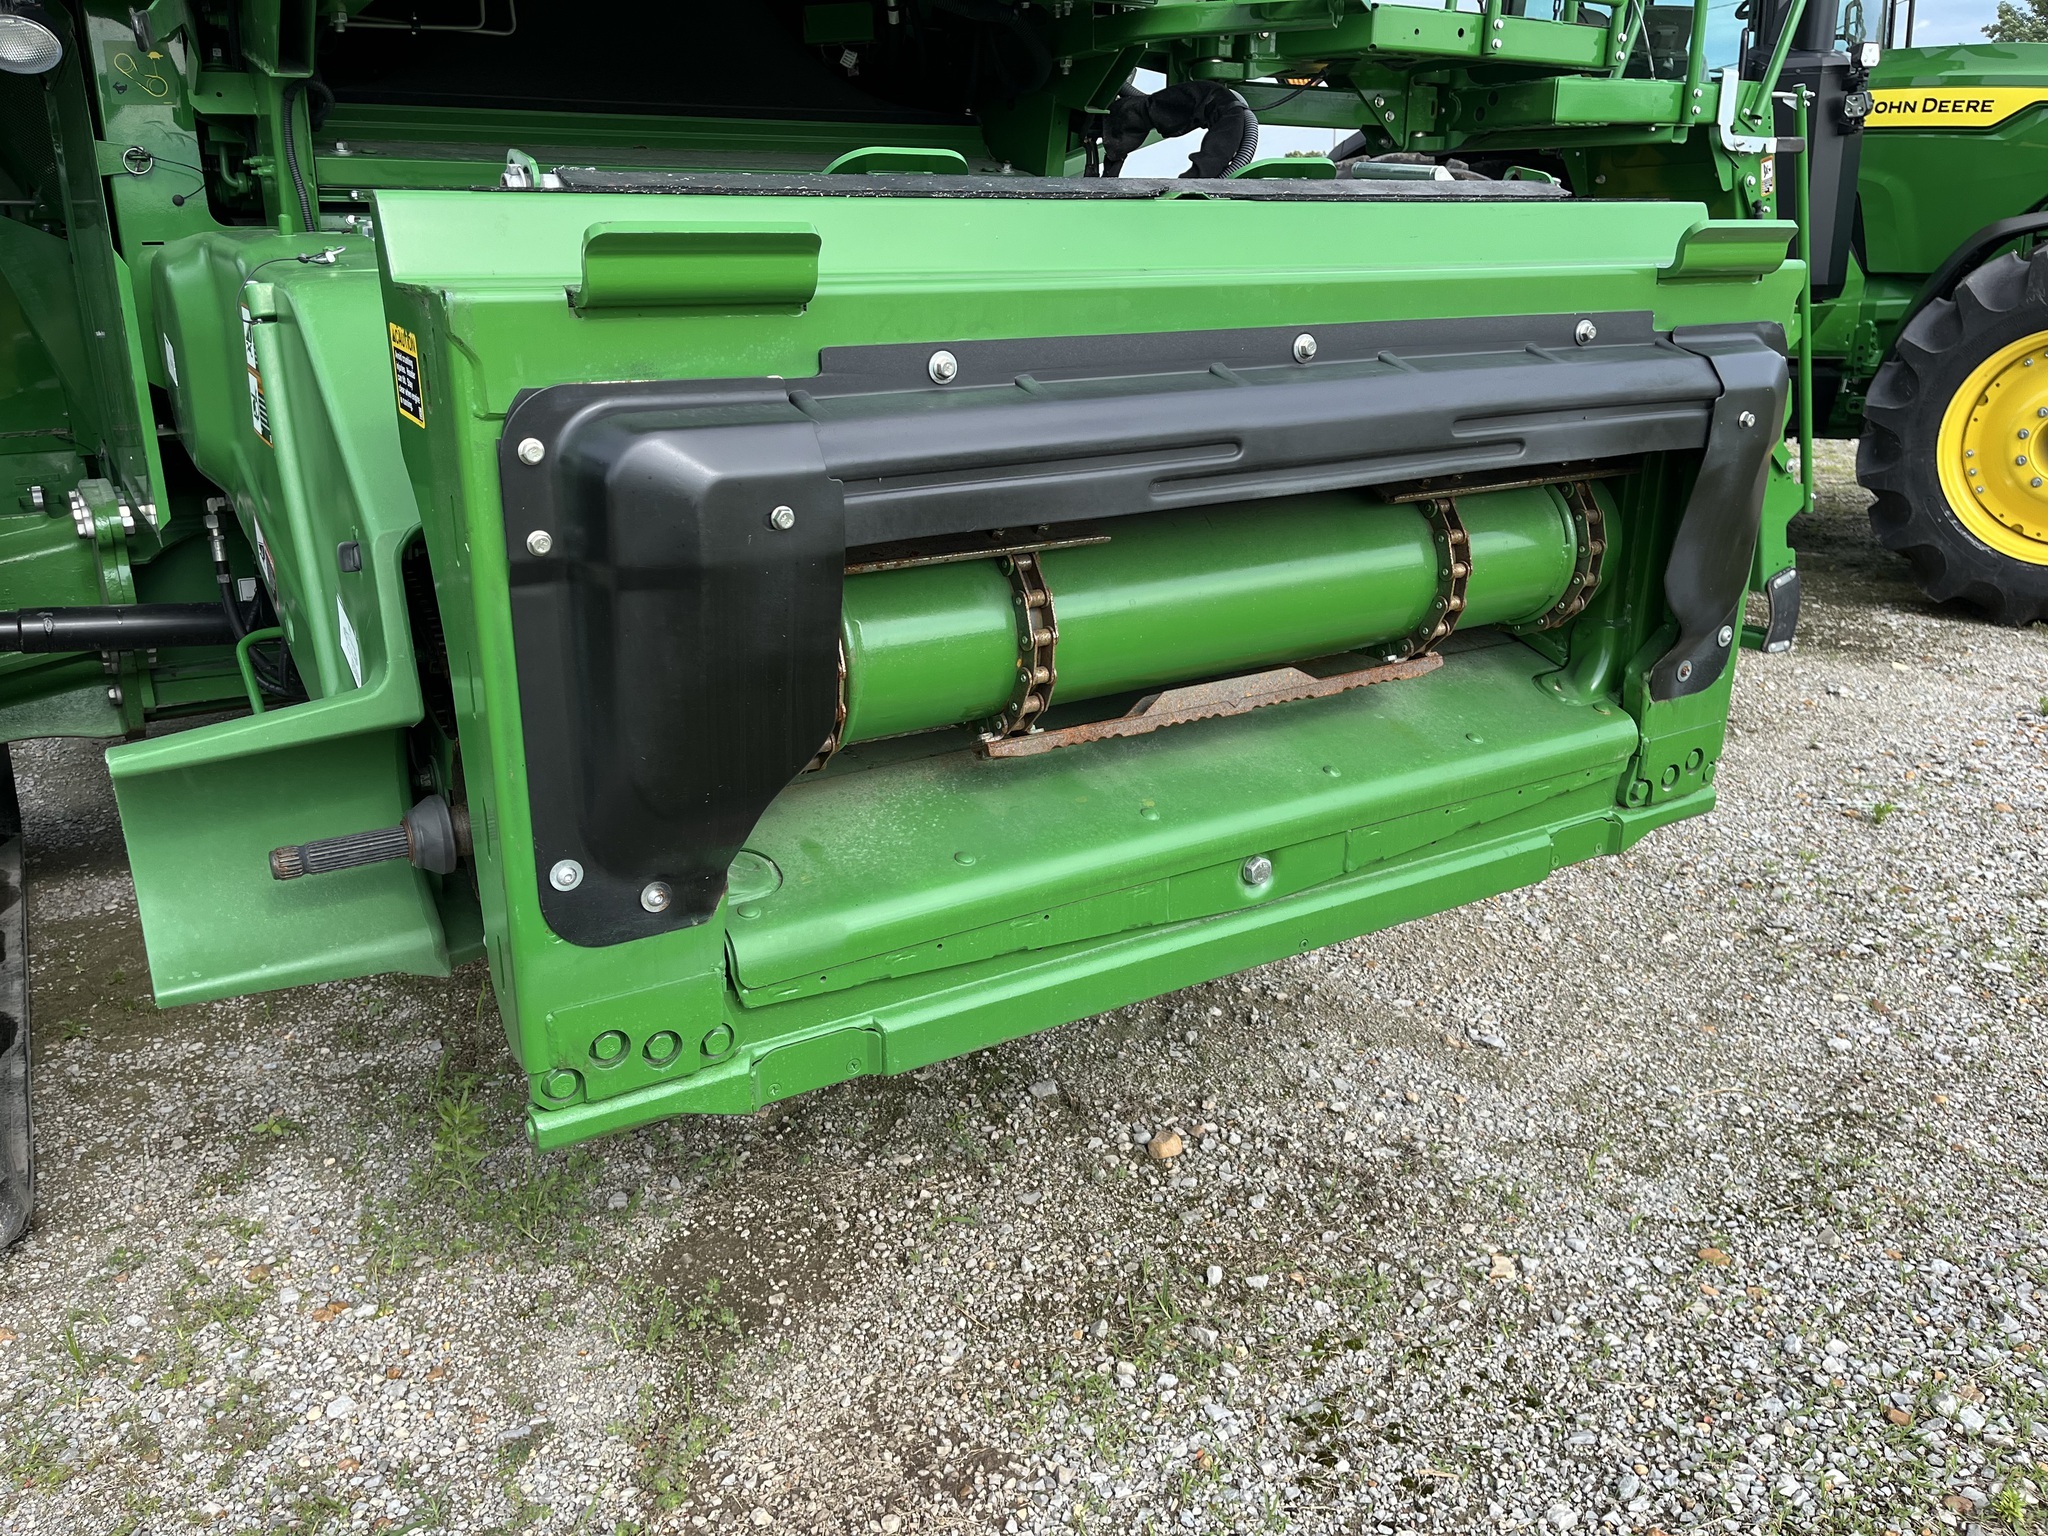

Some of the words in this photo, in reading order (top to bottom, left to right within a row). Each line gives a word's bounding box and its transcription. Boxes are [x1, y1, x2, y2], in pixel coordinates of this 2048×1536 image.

[1871, 100, 1917, 114] OHN
[1922, 98, 1994, 113] DEERE
[395, 325, 416, 352] CAUTION
